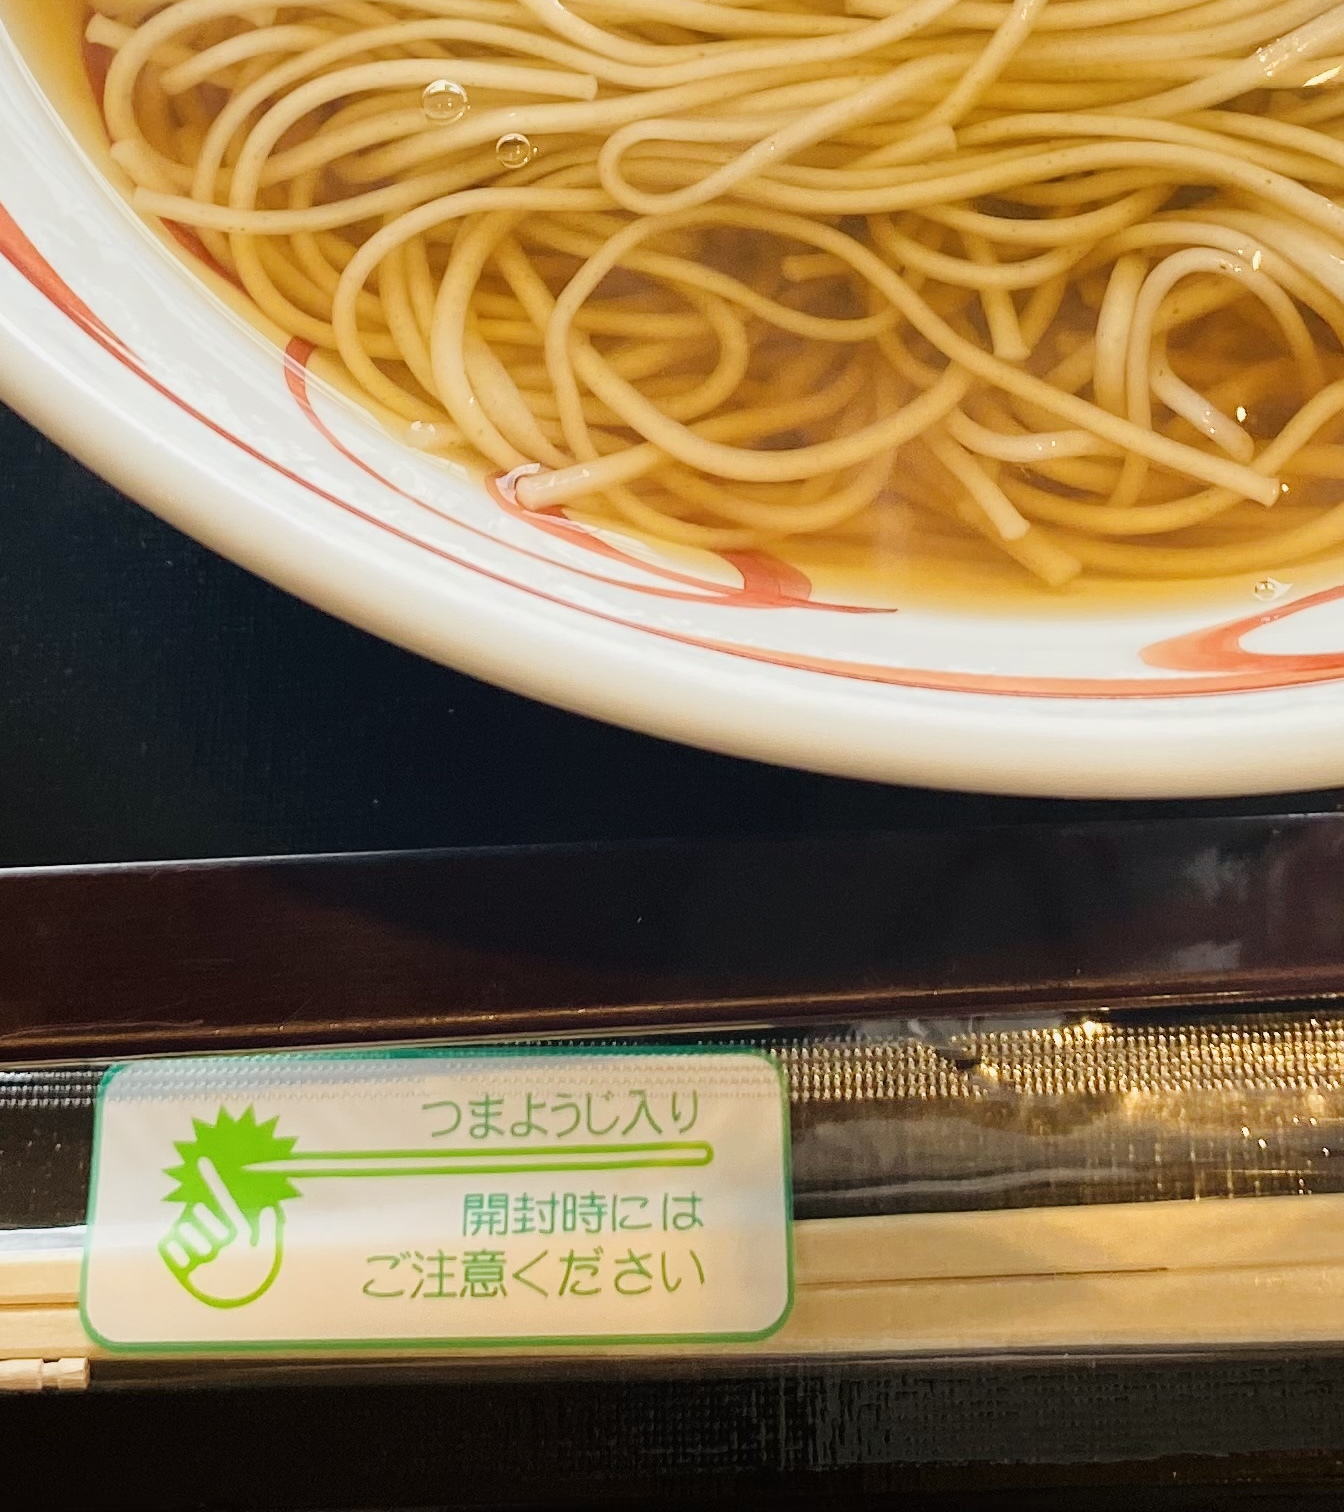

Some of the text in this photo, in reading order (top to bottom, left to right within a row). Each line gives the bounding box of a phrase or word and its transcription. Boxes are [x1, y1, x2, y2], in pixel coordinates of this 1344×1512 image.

[421, 1089, 700, 1140] つまようじ入り
[462, 1191, 704, 1237] 開封時には
[362, 1248, 707, 1301] ご注意ください
